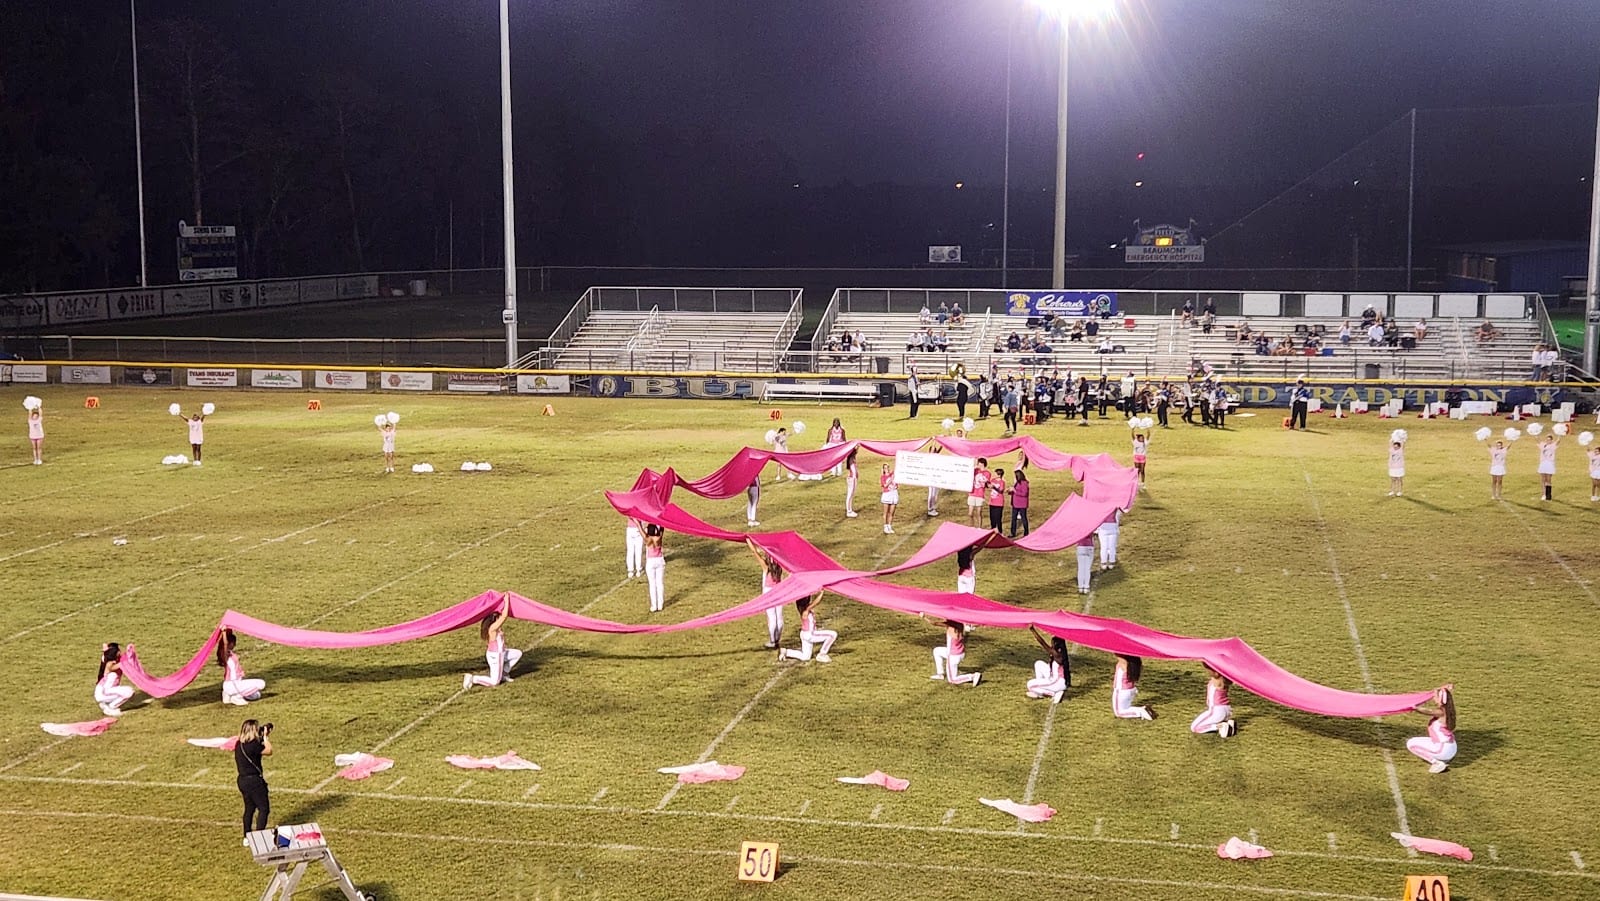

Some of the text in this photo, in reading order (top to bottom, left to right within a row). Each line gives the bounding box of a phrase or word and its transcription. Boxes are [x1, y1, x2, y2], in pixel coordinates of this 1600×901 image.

[1222, 385, 1510, 405] ND RADITION
[308, 401, 318, 410] 20
[770, 410, 780, 420] 40
[1024, 415, 1034, 425] 50
[744, 847, 772, 878] 50
[1416, 879, 1446, 901] 40
